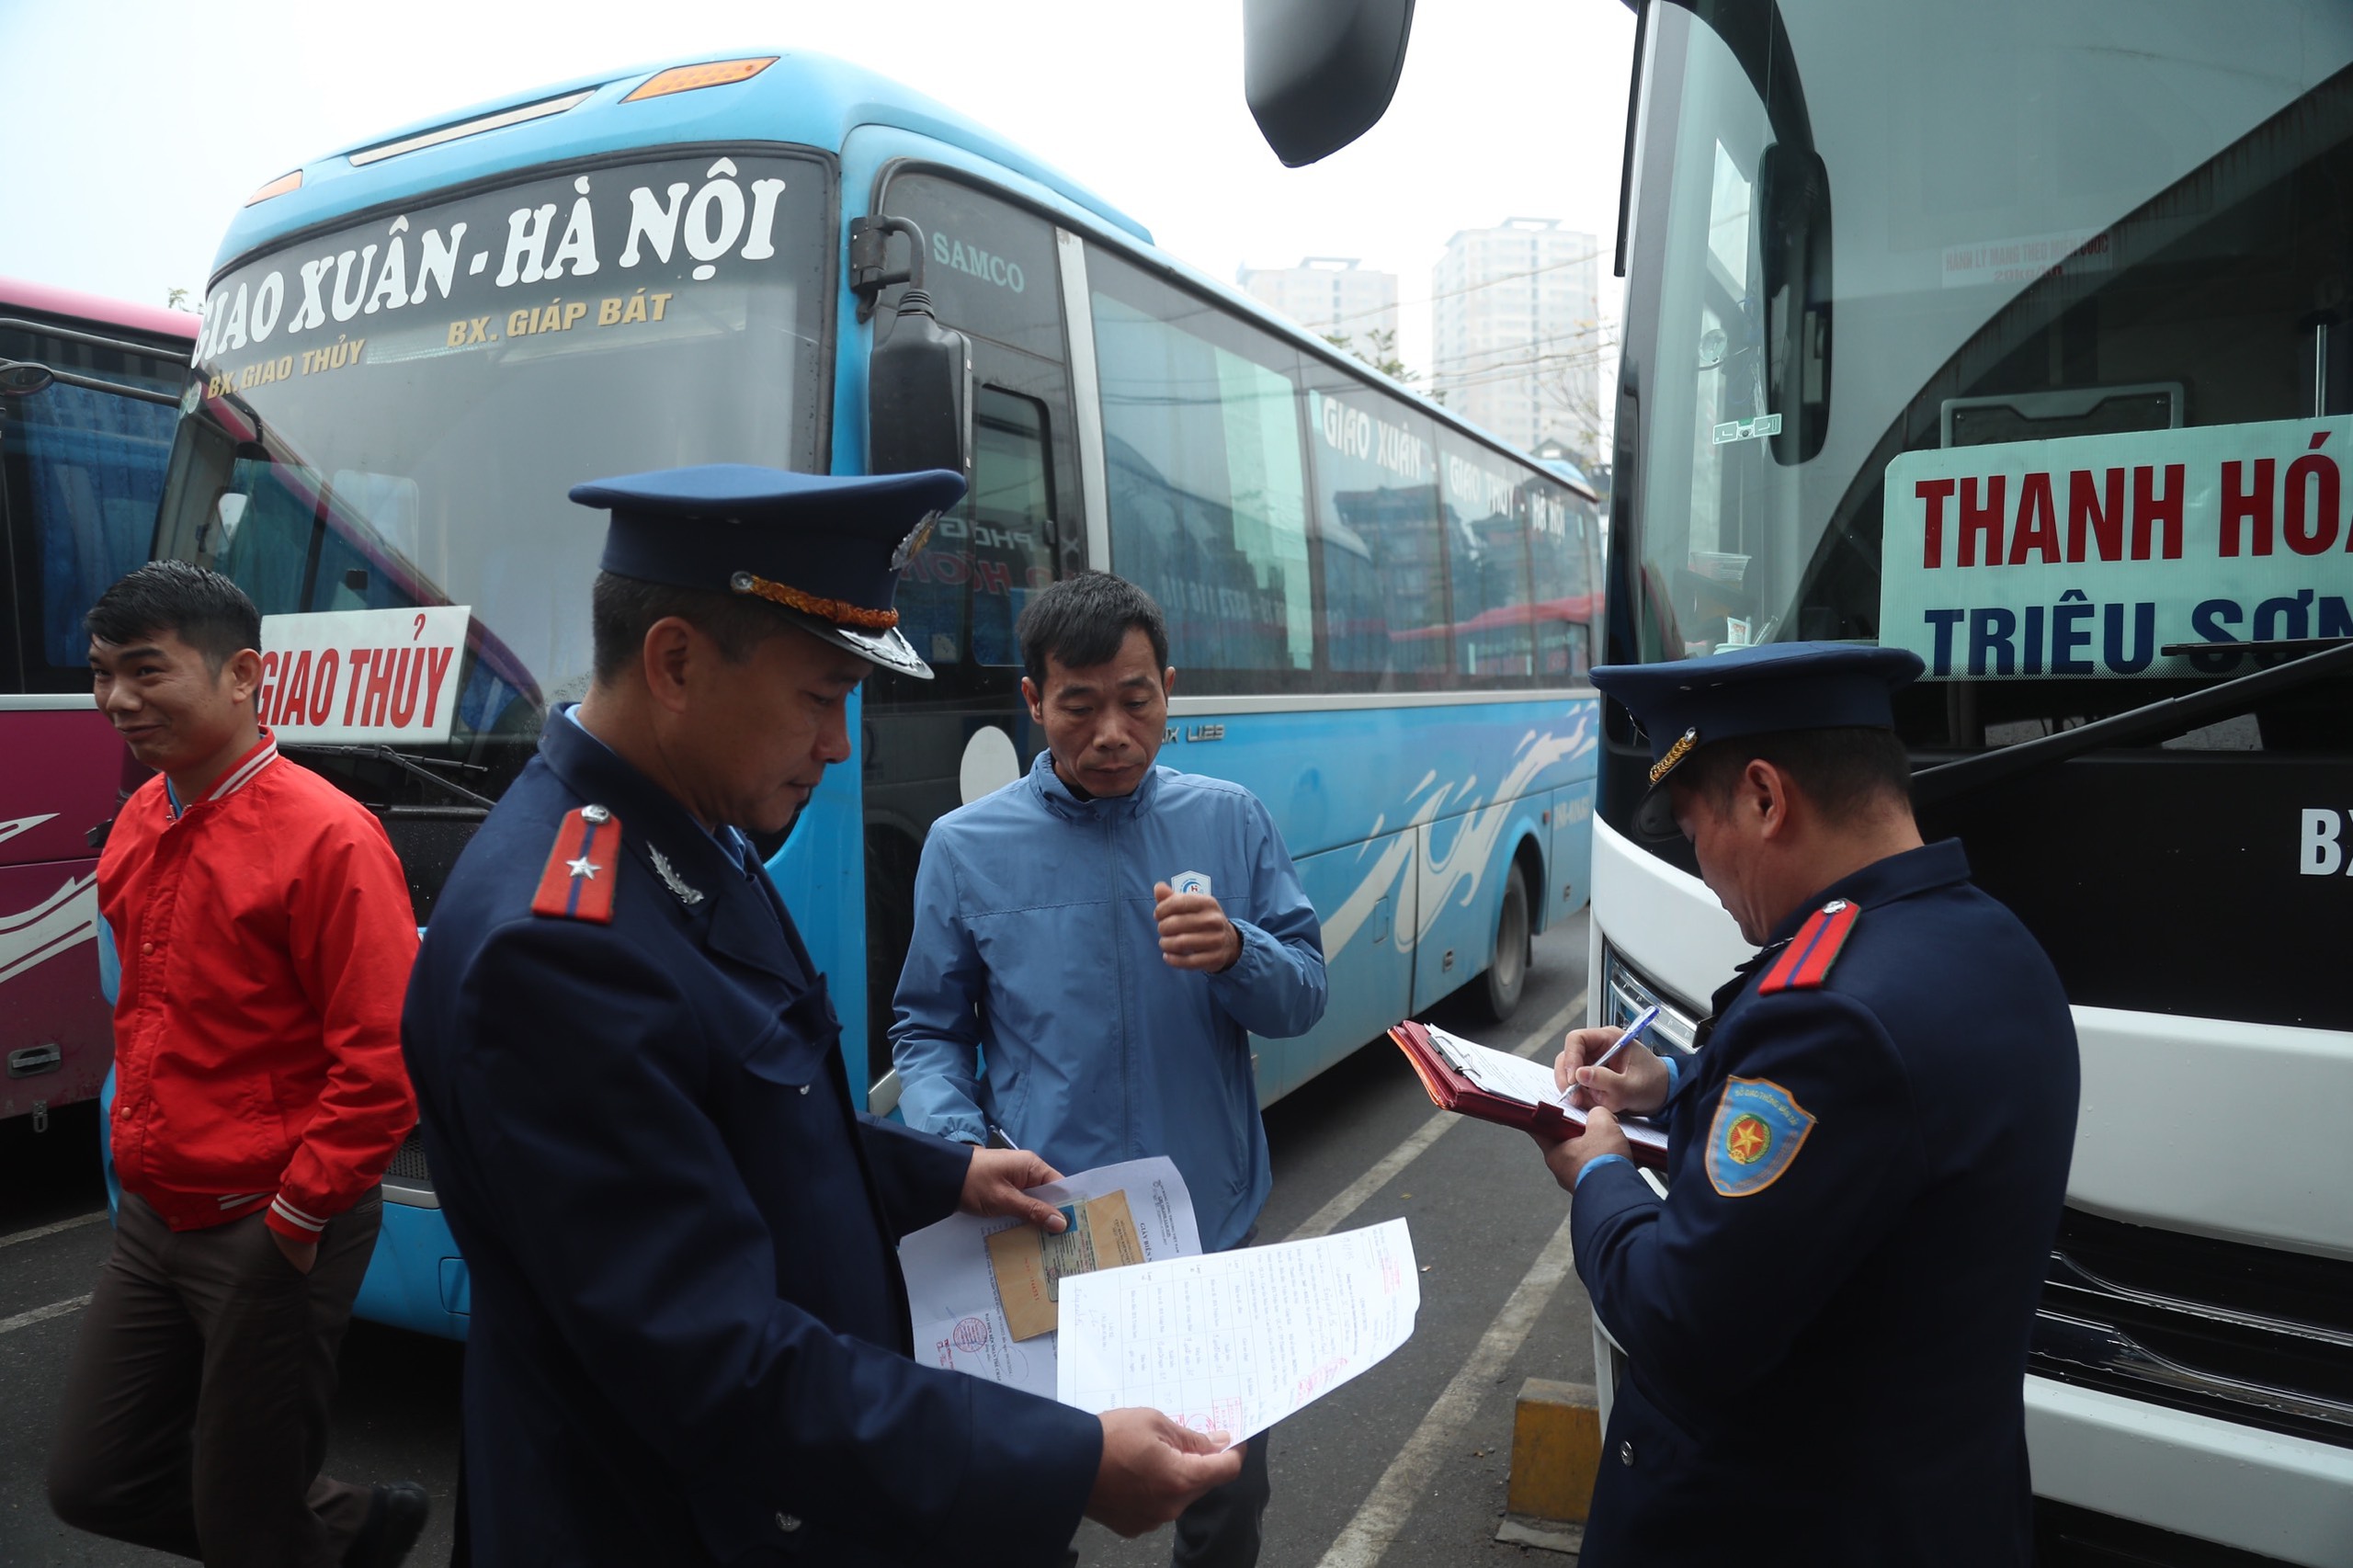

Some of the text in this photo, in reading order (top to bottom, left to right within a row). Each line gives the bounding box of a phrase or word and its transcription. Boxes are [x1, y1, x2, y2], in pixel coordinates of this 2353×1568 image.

[289, 215, 467, 334] XUÂN
[495, 176, 600, 288] HÀ
[619, 157, 786, 281] NỘI
[932, 232, 1025, 293] SAMCO
[301, 334, 366, 375] THỦY
[506, 298, 588, 337] GIÁP
[598, 288, 673, 326] BÁT
[1322, 396, 1370, 460] GIAO
[1377, 420, 1422, 482] XUÂN
[1915, 431, 2353, 569] THANH HÓ
[257, 613, 454, 729] GIAO THỦY
